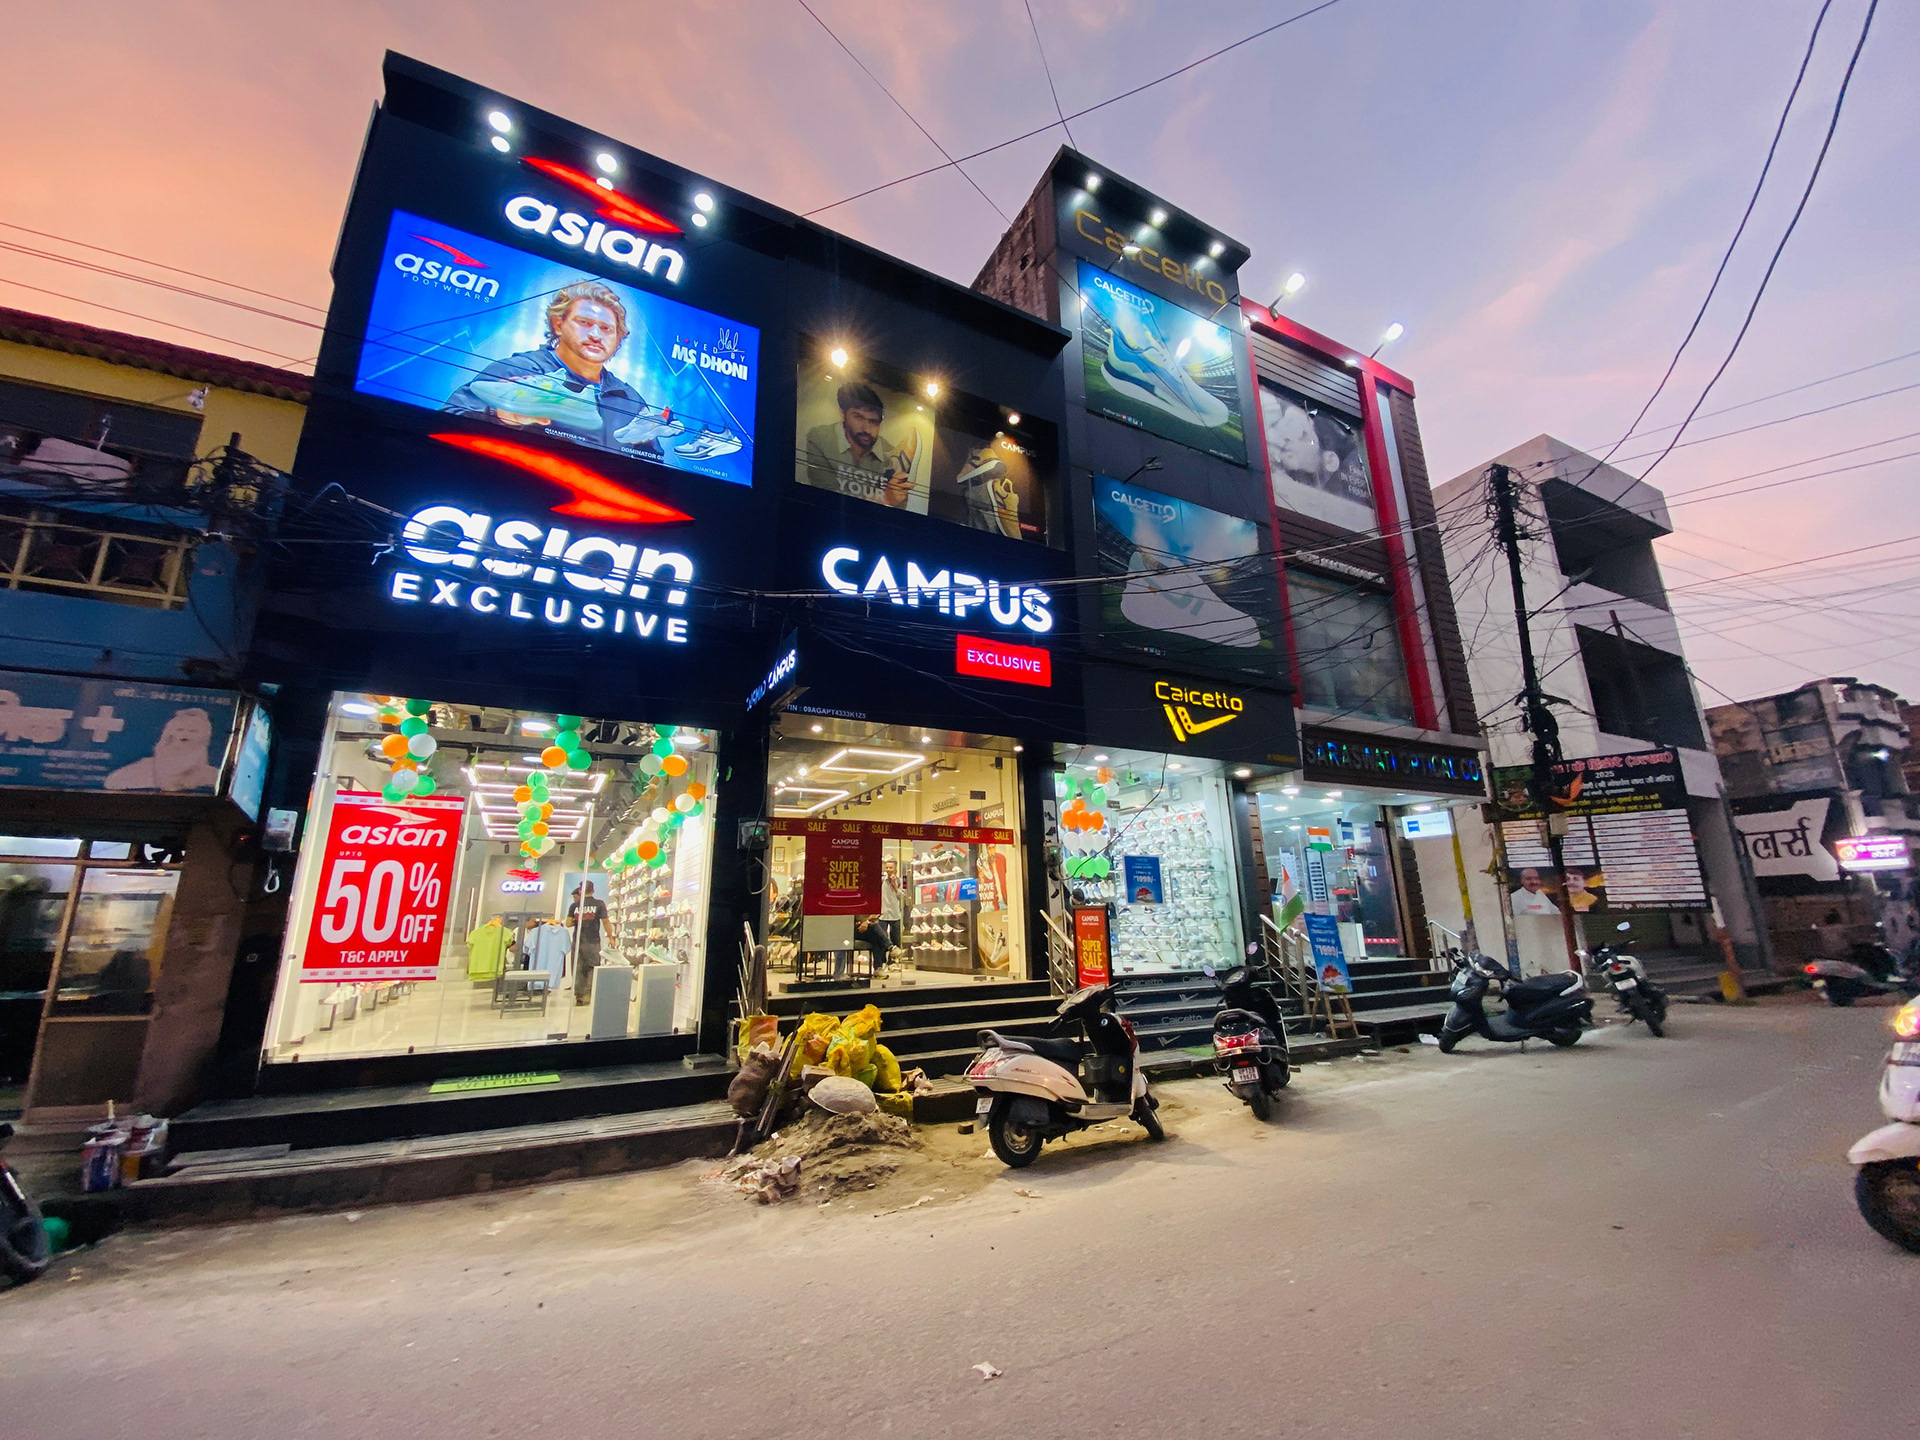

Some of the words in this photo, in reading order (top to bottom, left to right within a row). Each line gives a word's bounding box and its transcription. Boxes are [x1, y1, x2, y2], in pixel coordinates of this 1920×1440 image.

[505, 195, 684, 284] asian
[394, 253, 500, 298] asian
[402, 272, 490, 304] FOOTWEARS
[671, 343, 697, 365] MS
[700, 352, 748, 381] DHONI
[1000, 440, 1037, 458] CAMPUS
[837, 465, 888, 490] MOVE
[1111, 490, 1176, 524] CALCETTO
[402, 505, 694, 606] asian
[822, 547, 1053, 633] CAMPUS
[391, 572, 688, 643] EXCLUSIVE
[967, 650, 1041, 673] EXCLUSIVE
[1594, 770, 1615, 779] 2025
[984, 807, 1004, 820] CAMPUS
[341, 825, 448, 847] asian
[807, 822, 827, 832] SALE
[842, 823, 861, 833] SALE
[871, 824, 890, 834] SALE
[907, 826, 924, 836] SALE
[937, 828, 954, 838] SALE
[962, 829, 979, 839] SALE
[993, 831, 1010, 841] SALE
[1743, 816, 1813, 860] लर्स
[829, 860, 860, 873] SUPER
[501, 880, 545, 892] asian
[828, 873, 860, 890] SALE
[979, 891, 995, 900] YOUR
[400, 914, 438, 944] OFF
[340, 951, 366, 963] T&C
[368, 949, 409, 963] APPLY
[1082, 939, 1102, 952] SUPER
[1082, 951, 1103, 969] SALE
